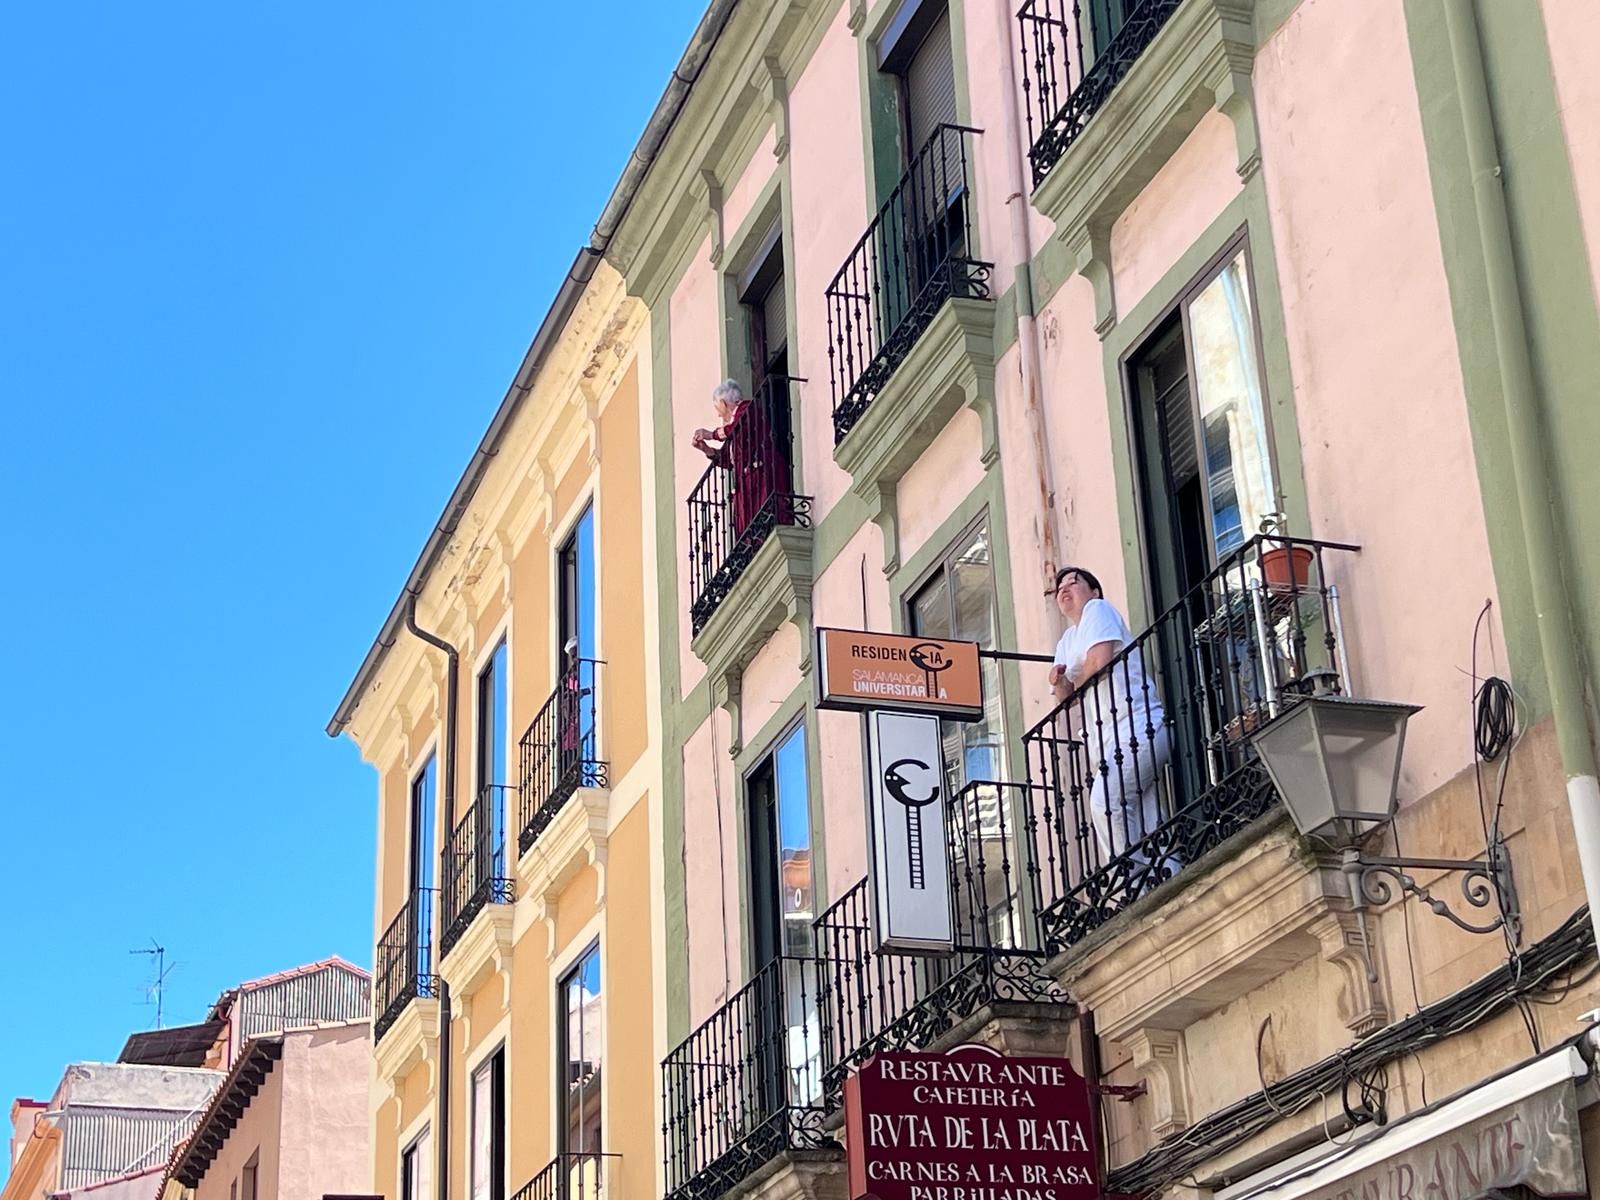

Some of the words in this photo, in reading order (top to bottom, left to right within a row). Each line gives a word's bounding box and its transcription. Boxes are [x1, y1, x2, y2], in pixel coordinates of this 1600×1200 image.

[852, 643, 953, 672] RESIDENCIA
[852, 668, 925, 684] SALAMANCA
[944, 1116, 974, 1149] DE
[981, 1118, 1010, 1150] LA
[1018, 1118, 1089, 1152] PLATA
[868, 1160, 959, 1182] CARNES
[966, 1163, 981, 1183] A
[989, 1164, 1015, 1184] LA
[1023, 1165, 1093, 1185] BRASA
